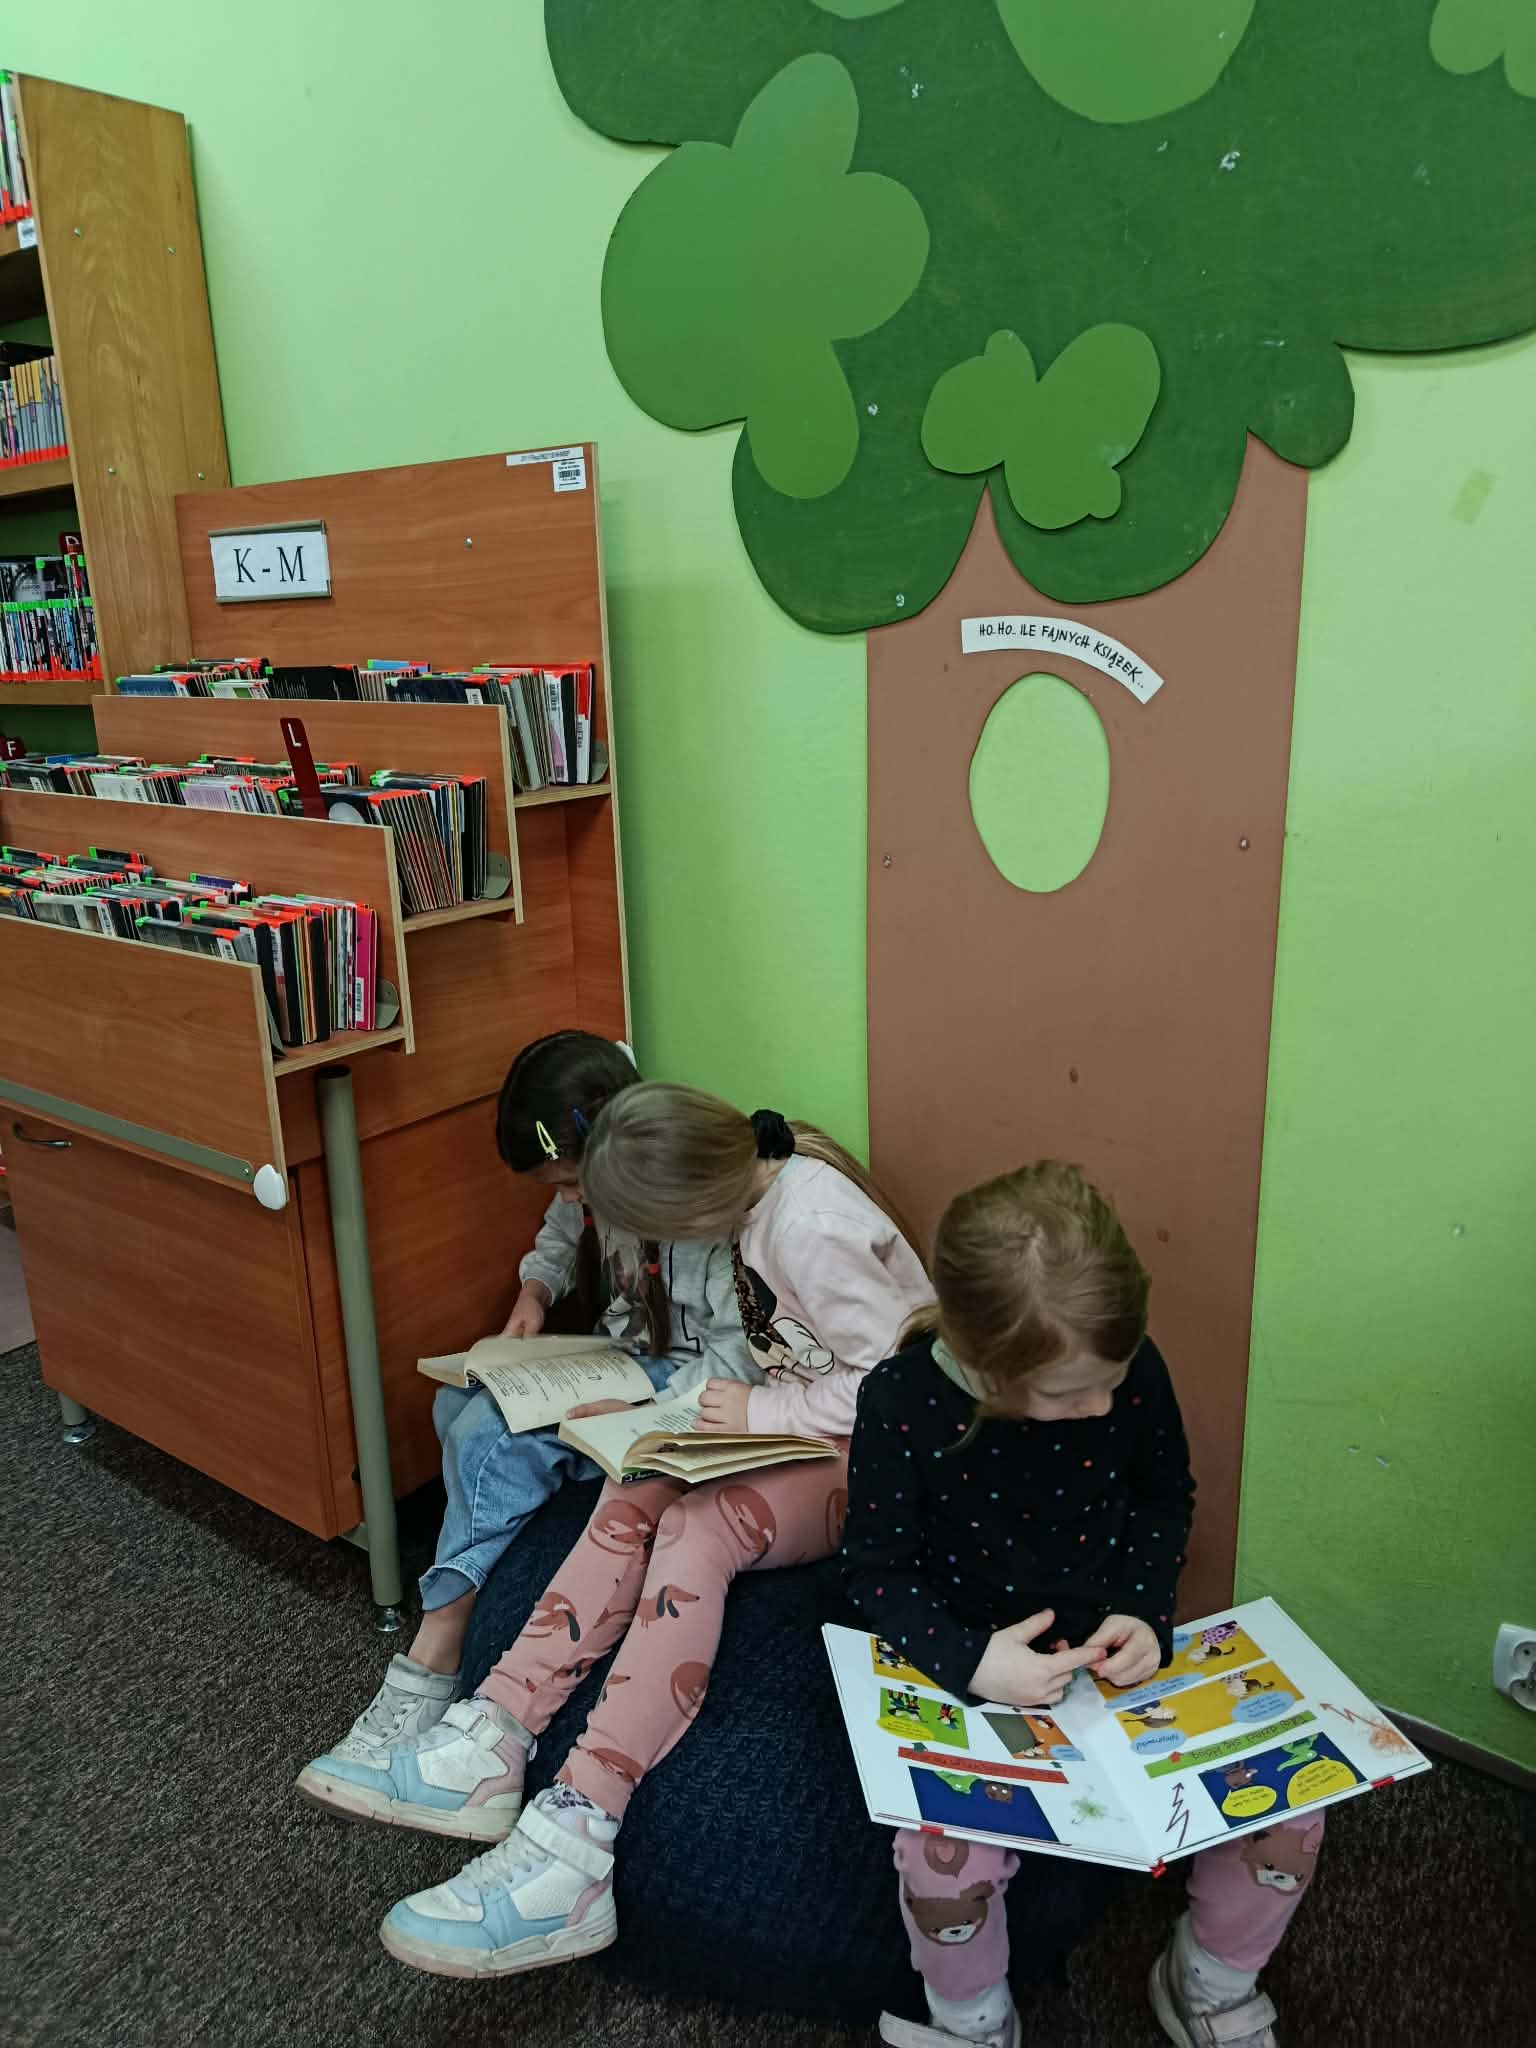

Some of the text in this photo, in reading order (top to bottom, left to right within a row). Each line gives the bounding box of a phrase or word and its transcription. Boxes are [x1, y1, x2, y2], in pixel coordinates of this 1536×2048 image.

[1020, 623, 1037, 637] ILE
[1041, 624, 1091, 649] FAJNYCH
[287, 722, 302, 747] L
[6, 740, 16, 757] F
